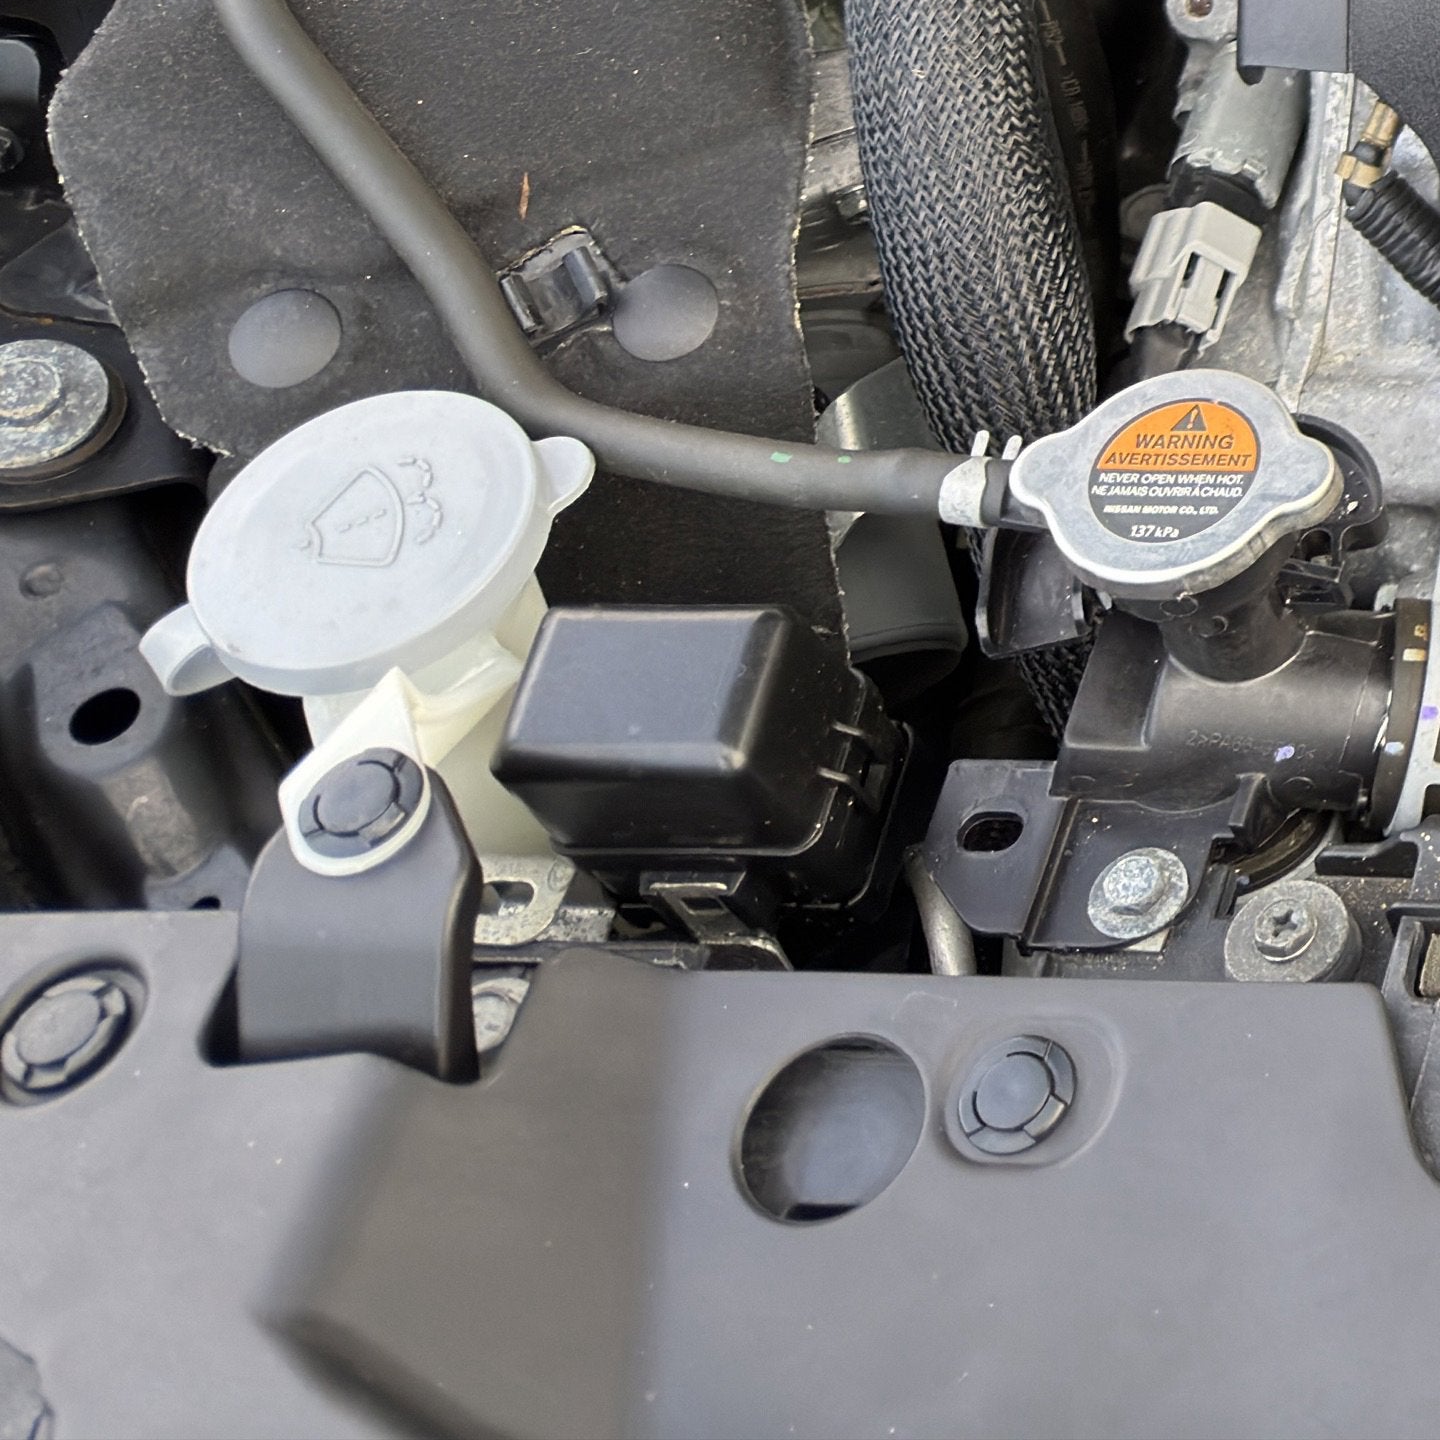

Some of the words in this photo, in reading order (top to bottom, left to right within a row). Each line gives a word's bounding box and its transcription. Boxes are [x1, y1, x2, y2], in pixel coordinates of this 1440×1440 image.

[1136, 434, 1235, 450] WARNING
[1105, 452, 1253, 467] AVERTISSEMENT
[1099, 473, 1140, 484] NEVER
[1141, 473, 1177, 484] OPEN
[1177, 473, 1217, 484] WHEN
[1217, 474, 1244, 484] HOT.
[1091, 485, 1108, 495] NE
[1107, 486, 1148, 496] JAMAIS
[1149, 486, 1192, 497] OUVRIR
[1202, 487, 1243, 497] CHAUD.
[1104, 505, 1142, 514] NISSAN
[1143, 505, 1178, 514] MOTOR
[1130, 525, 1156, 537] 137
[1156, 526, 1179, 537] kPa
